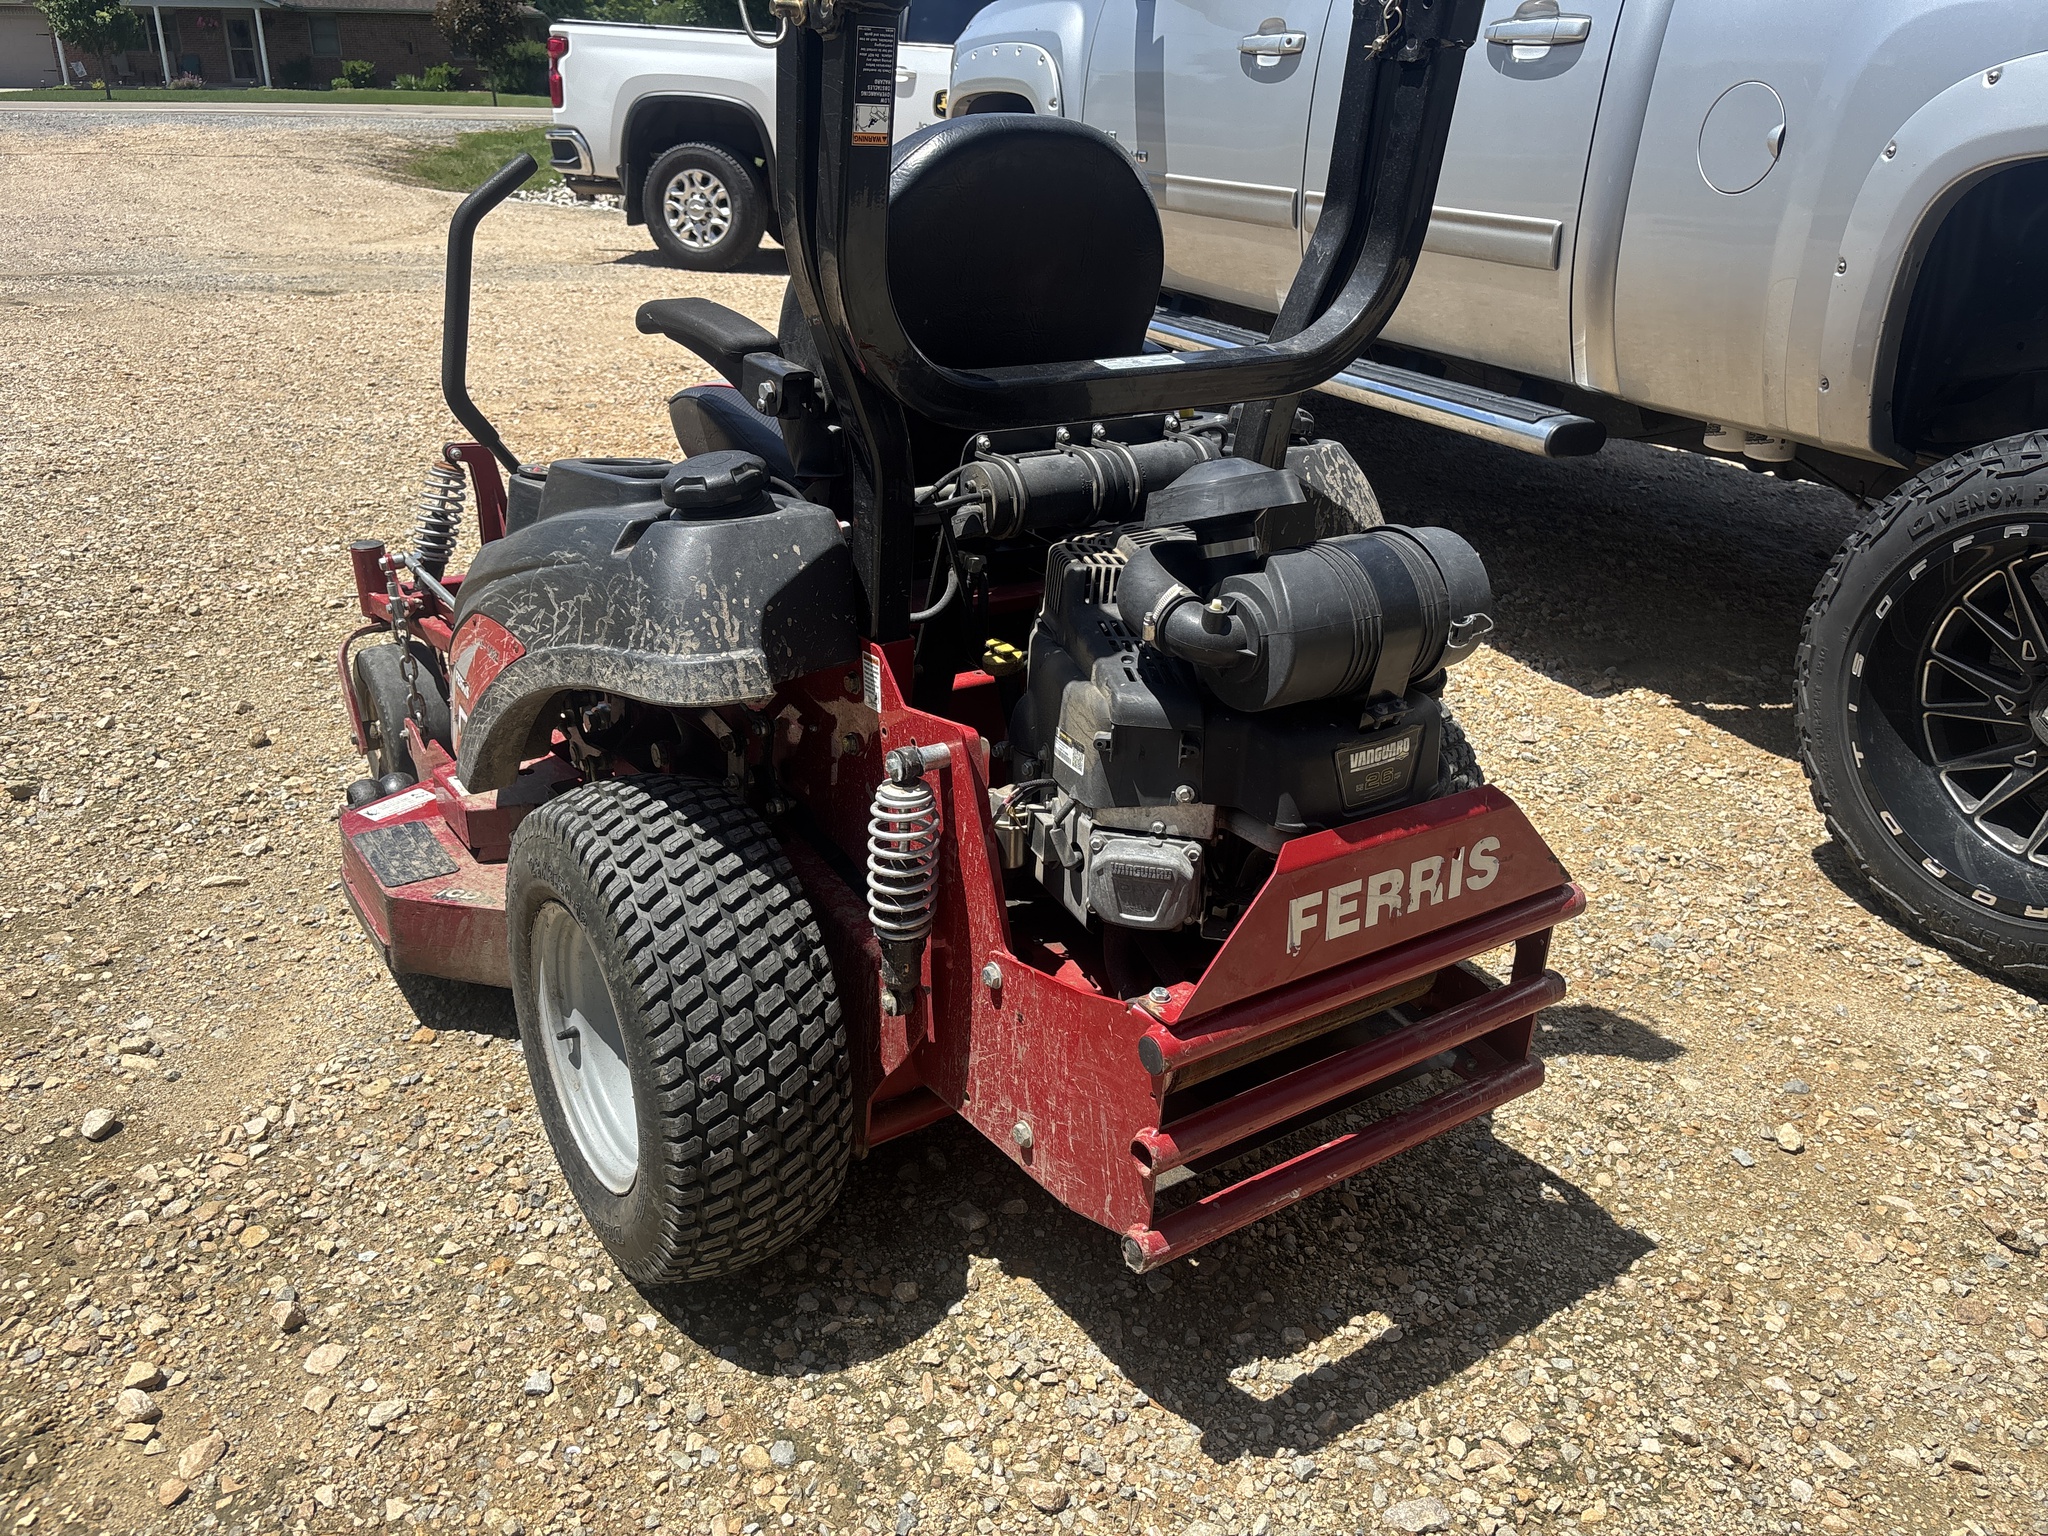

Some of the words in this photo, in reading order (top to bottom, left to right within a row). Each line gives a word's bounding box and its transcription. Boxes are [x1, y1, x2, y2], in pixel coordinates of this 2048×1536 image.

[860, 90, 891, 98] OVERHANGING
[854, 135, 882, 143] WARNING
[1937, 484, 2027, 525] VENOM
[1349, 737, 1410, 769] VANGUARD
[1364, 766, 1395, 791] 26
[1110, 861, 1173, 880] VANGUARD
[1286, 836, 1501, 957] FERRIS
